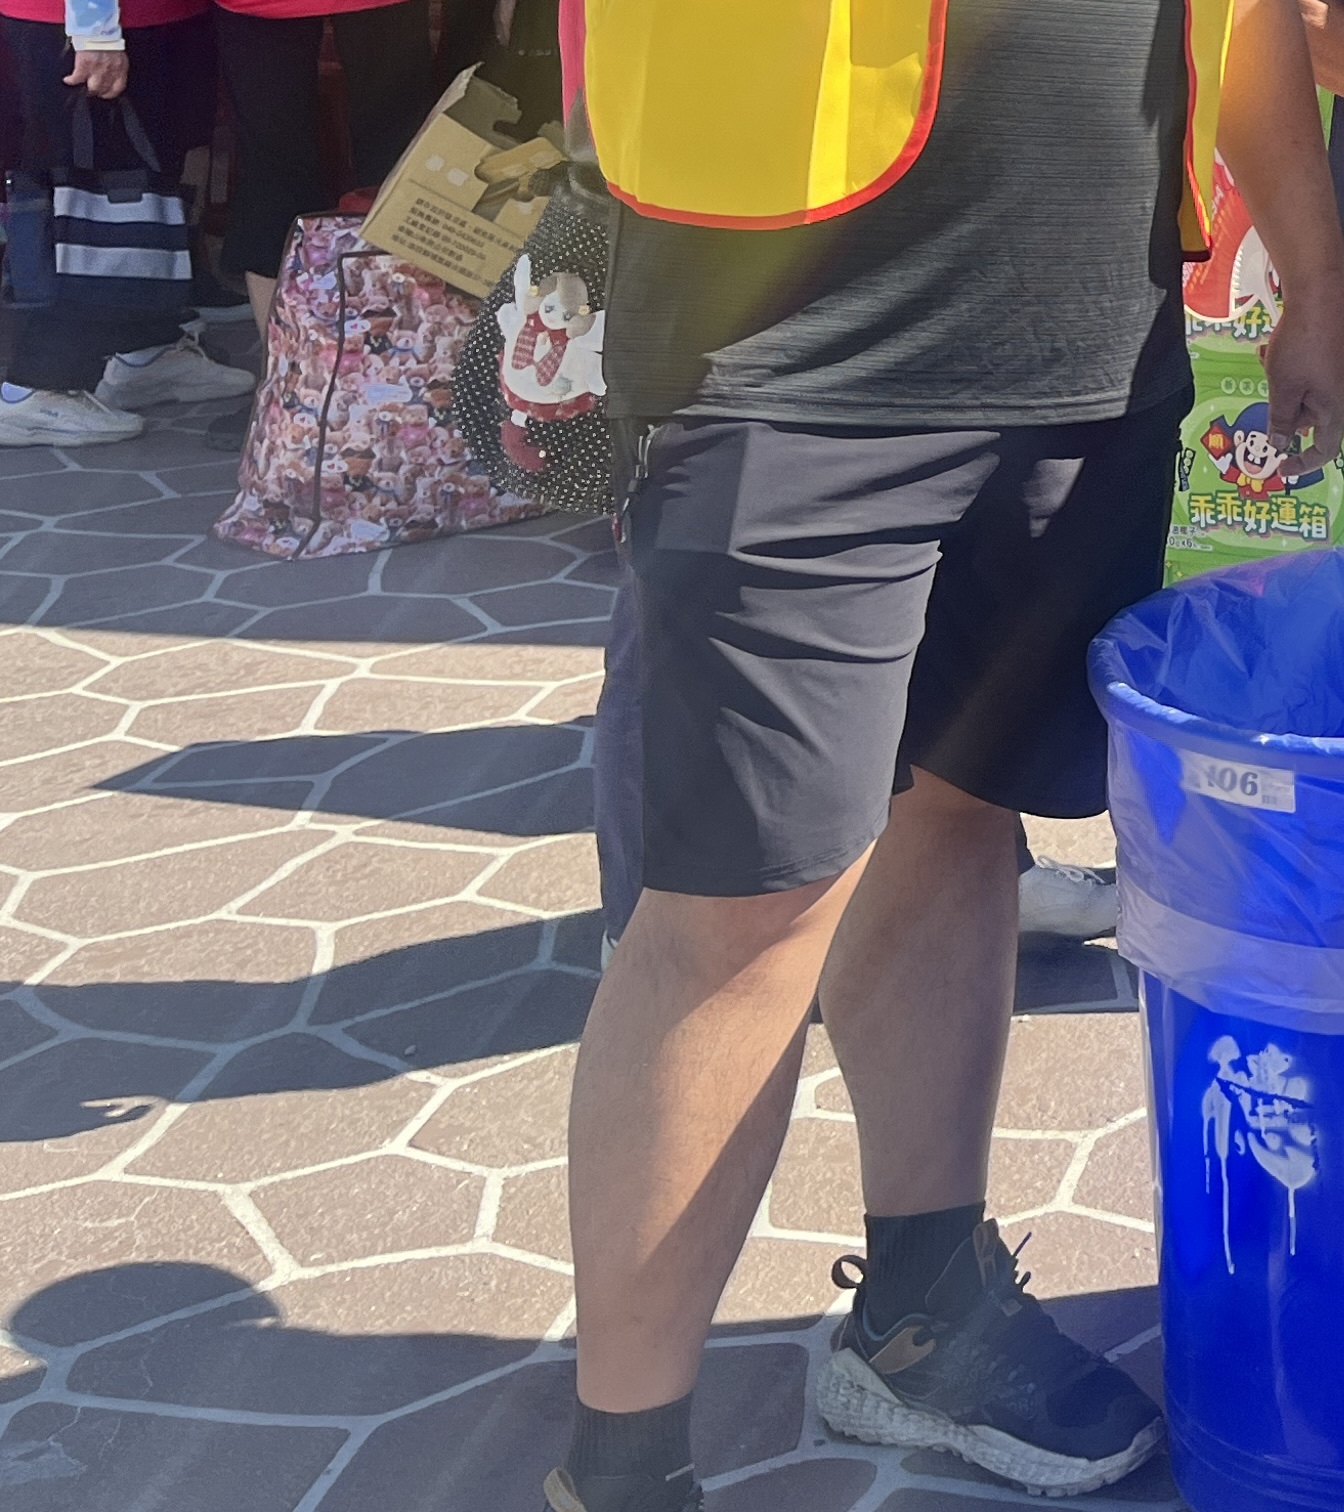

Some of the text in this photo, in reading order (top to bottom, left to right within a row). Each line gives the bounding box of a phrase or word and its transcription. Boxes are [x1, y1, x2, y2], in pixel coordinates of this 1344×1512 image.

[1189, 490, 1331, 539] 乖乖好運箱
